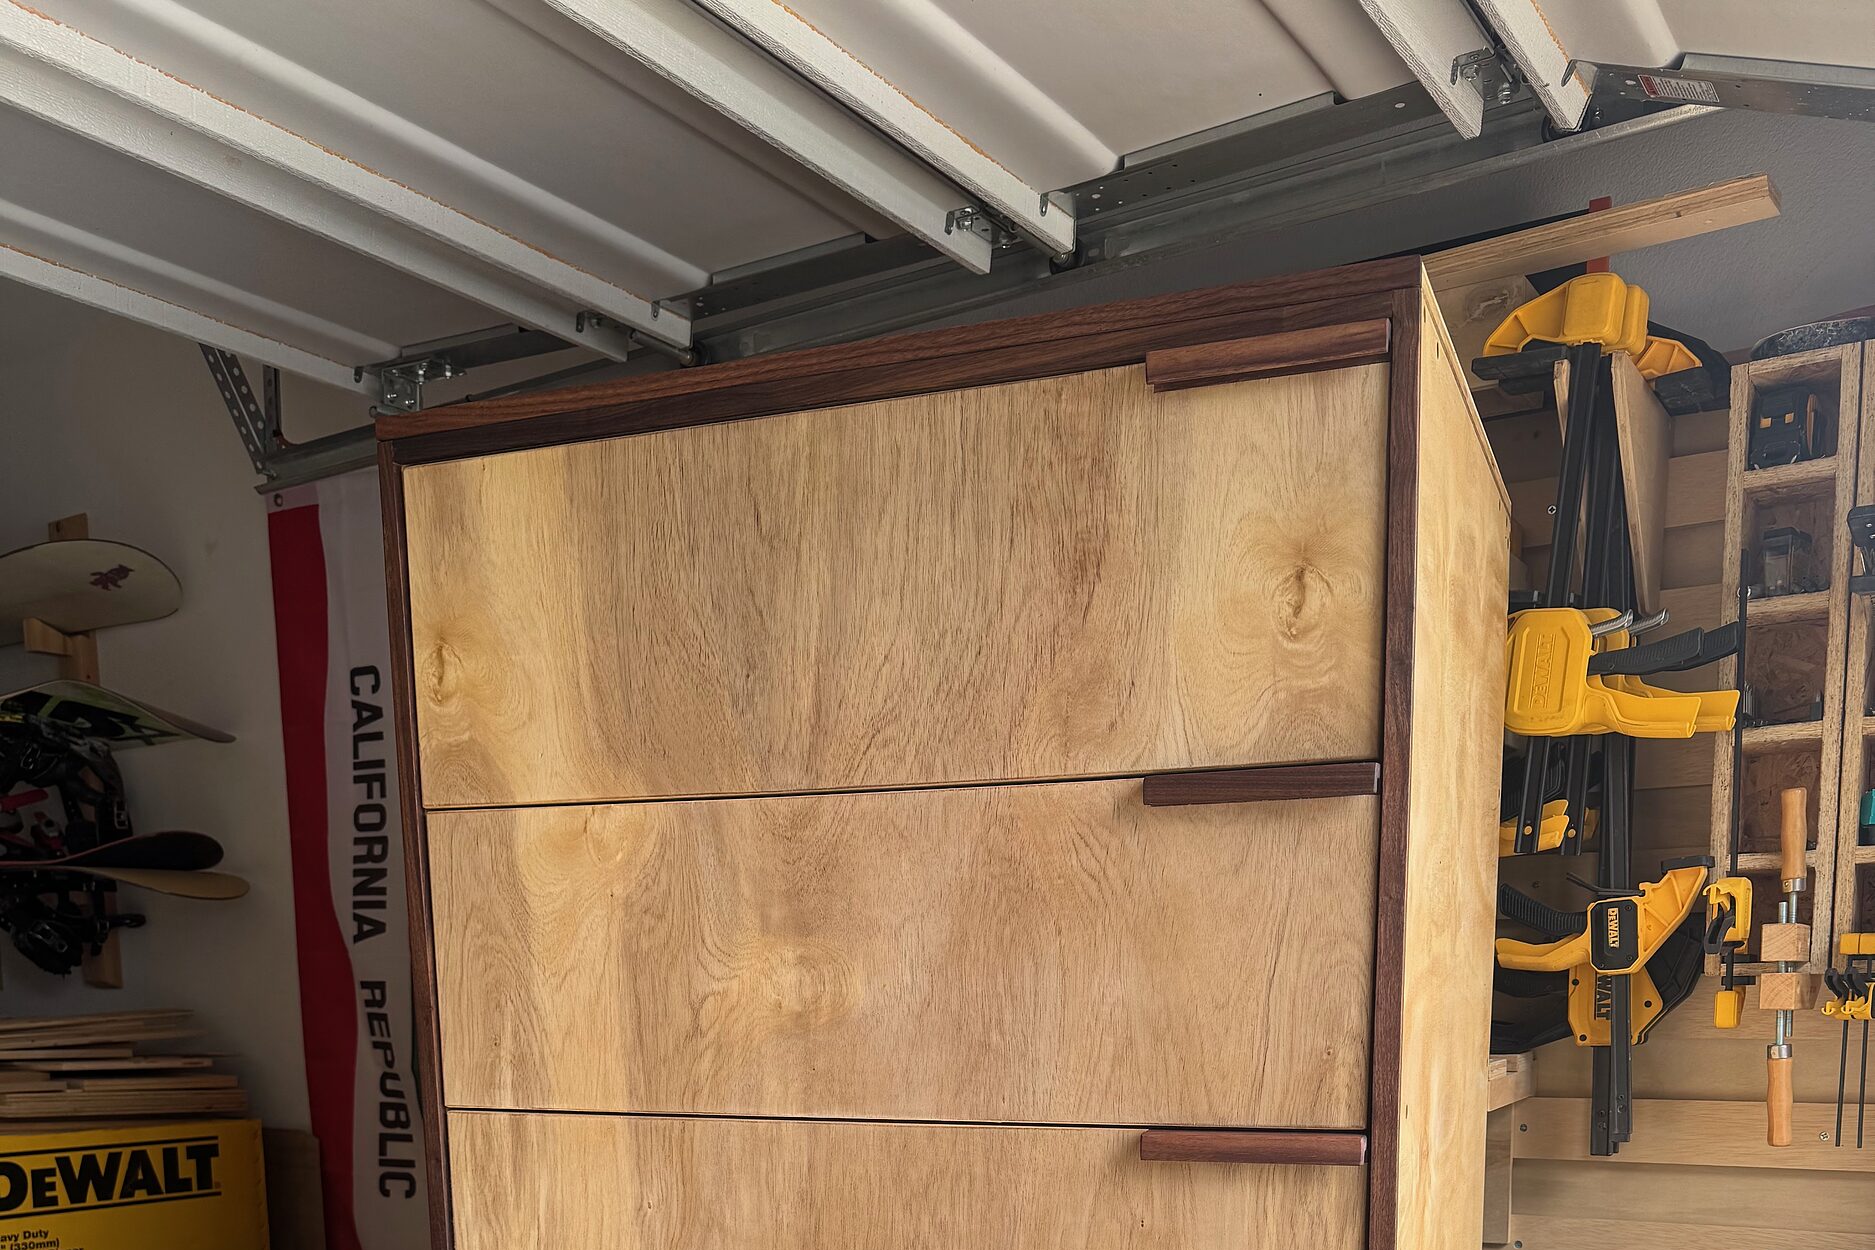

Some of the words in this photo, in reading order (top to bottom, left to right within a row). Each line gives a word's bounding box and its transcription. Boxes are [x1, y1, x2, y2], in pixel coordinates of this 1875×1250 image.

[349, 664, 389, 944] CALIFORNIA
[360, 980, 417, 1199] REPUBLIC
[23, 1229, 49, 1241] Duty
